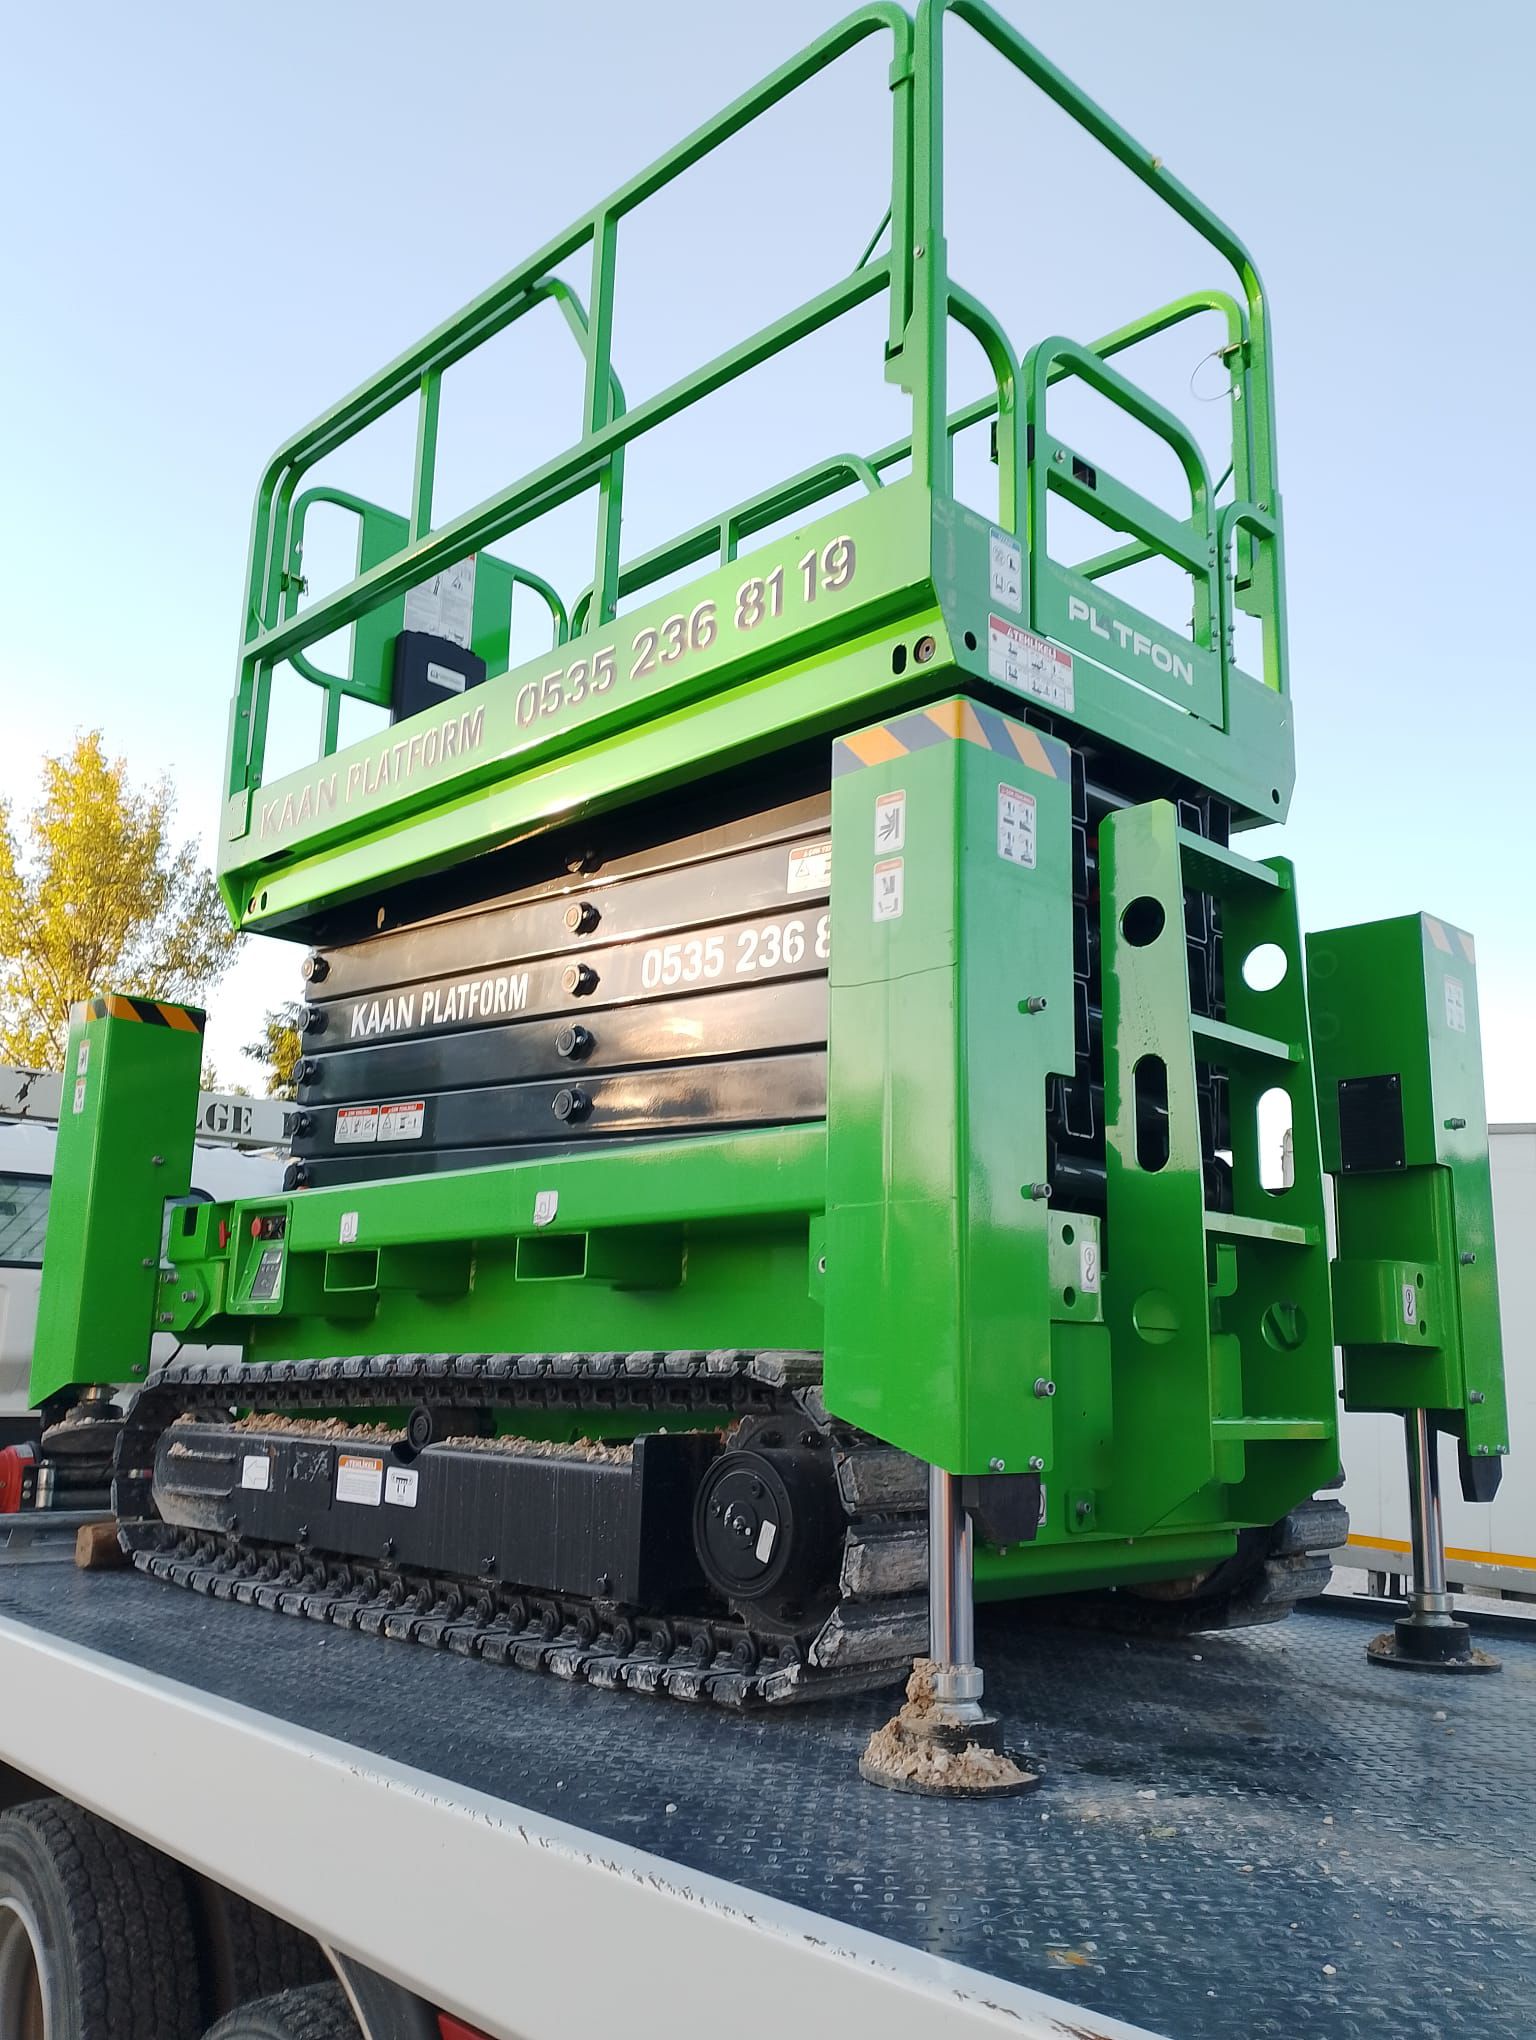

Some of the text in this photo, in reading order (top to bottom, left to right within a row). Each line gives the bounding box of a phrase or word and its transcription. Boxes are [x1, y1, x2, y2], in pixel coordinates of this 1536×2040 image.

[259, 772, 337, 841] KAAN
[345, 704, 486, 804] PLATFORM
[515, 644, 617, 728] 0535
[629, 599, 718, 680] 236
[350, 993, 415, 1038] KAAN
[420, 972, 529, 1027] PLATFORM
[641, 935, 725, 989] 0535
[735, 919, 806, 974] 236
[196, 1102, 253, 1136] GE
